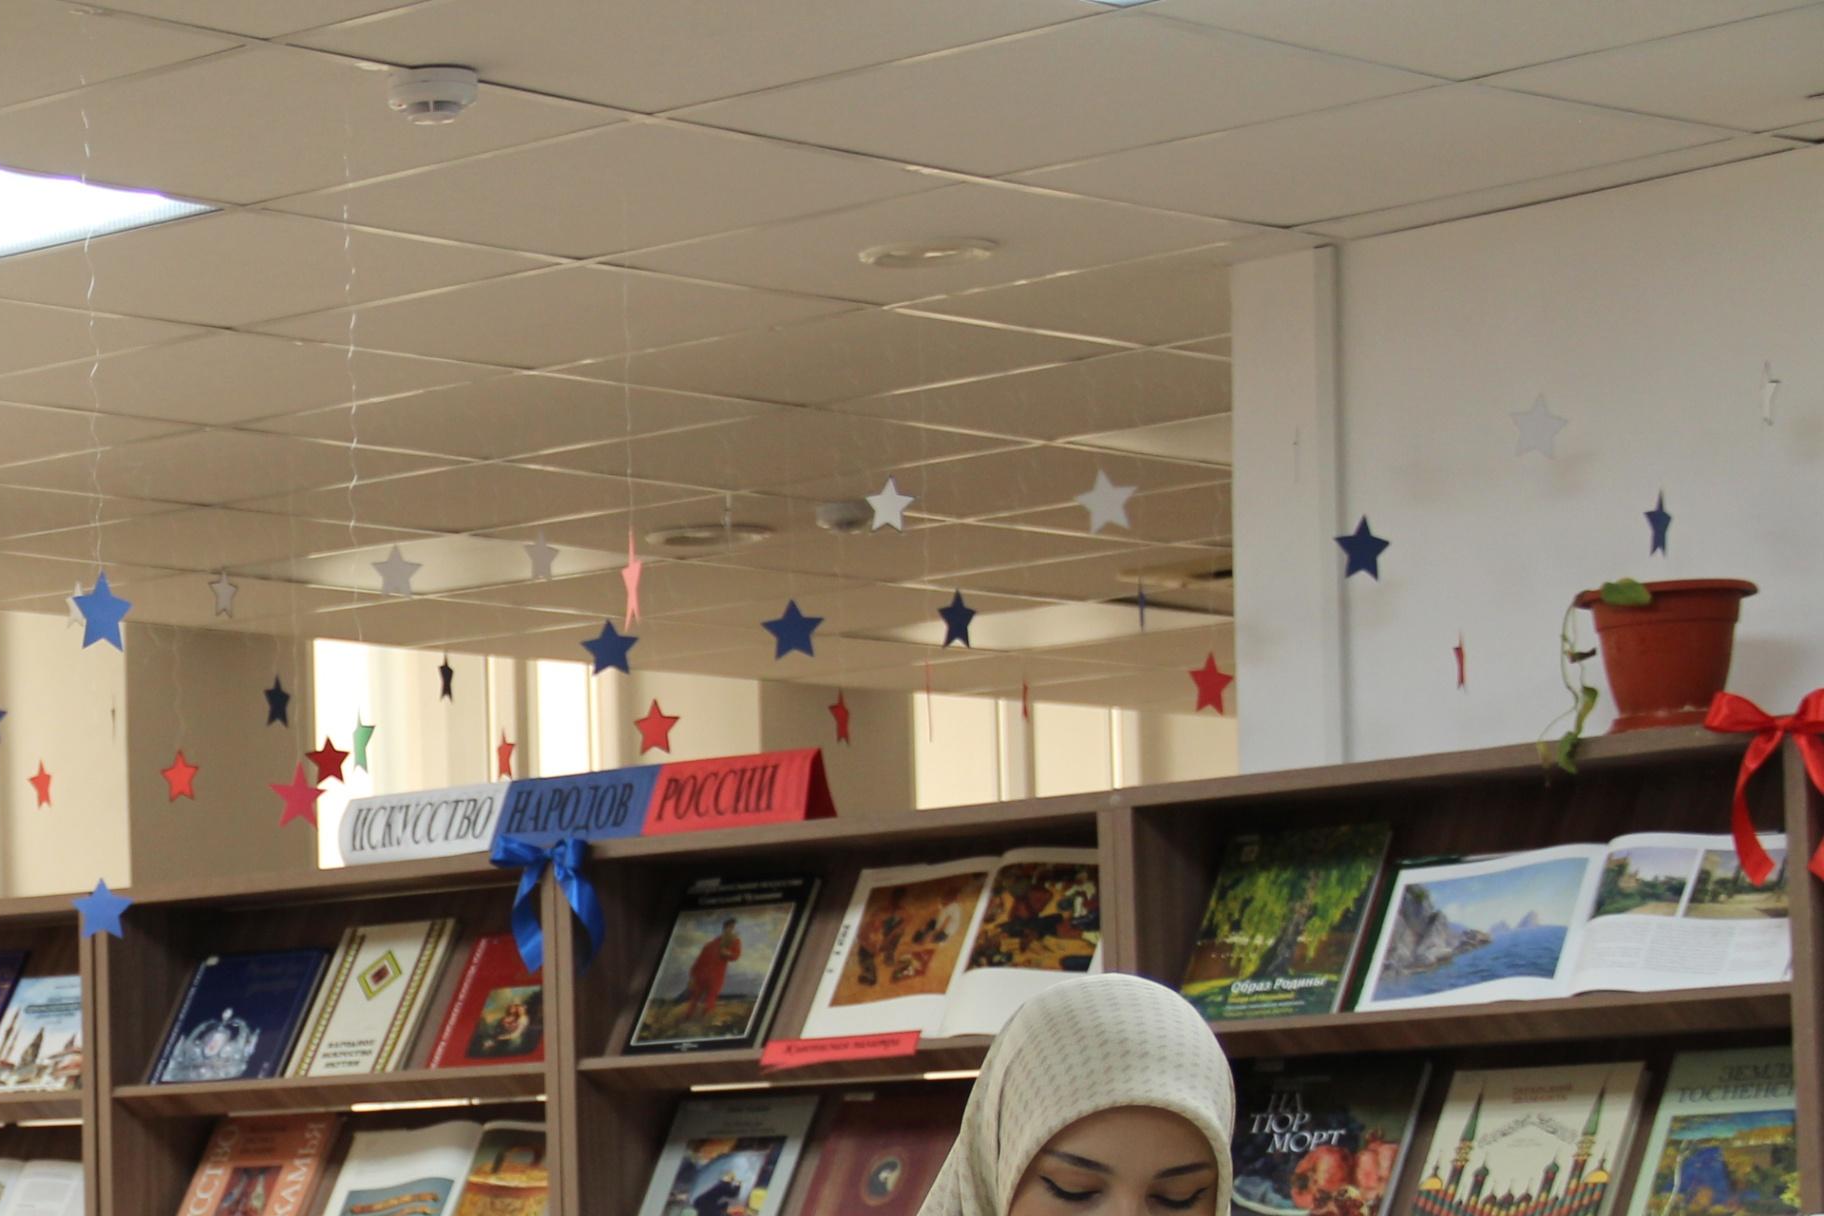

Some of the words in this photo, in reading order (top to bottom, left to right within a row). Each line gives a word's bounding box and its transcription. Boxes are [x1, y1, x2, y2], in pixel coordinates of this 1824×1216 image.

[350, 794, 494, 852] ИСКУССТВО
[504, 782, 634, 836] НАРОДОВ
[655, 764, 780, 822] РОССИИ
[1678, 1082, 1794, 1103] ТОСНЕНС
[1250, 1112, 1312, 1134] ТЮР
[1267, 1128, 1346, 1153] МОРТ
